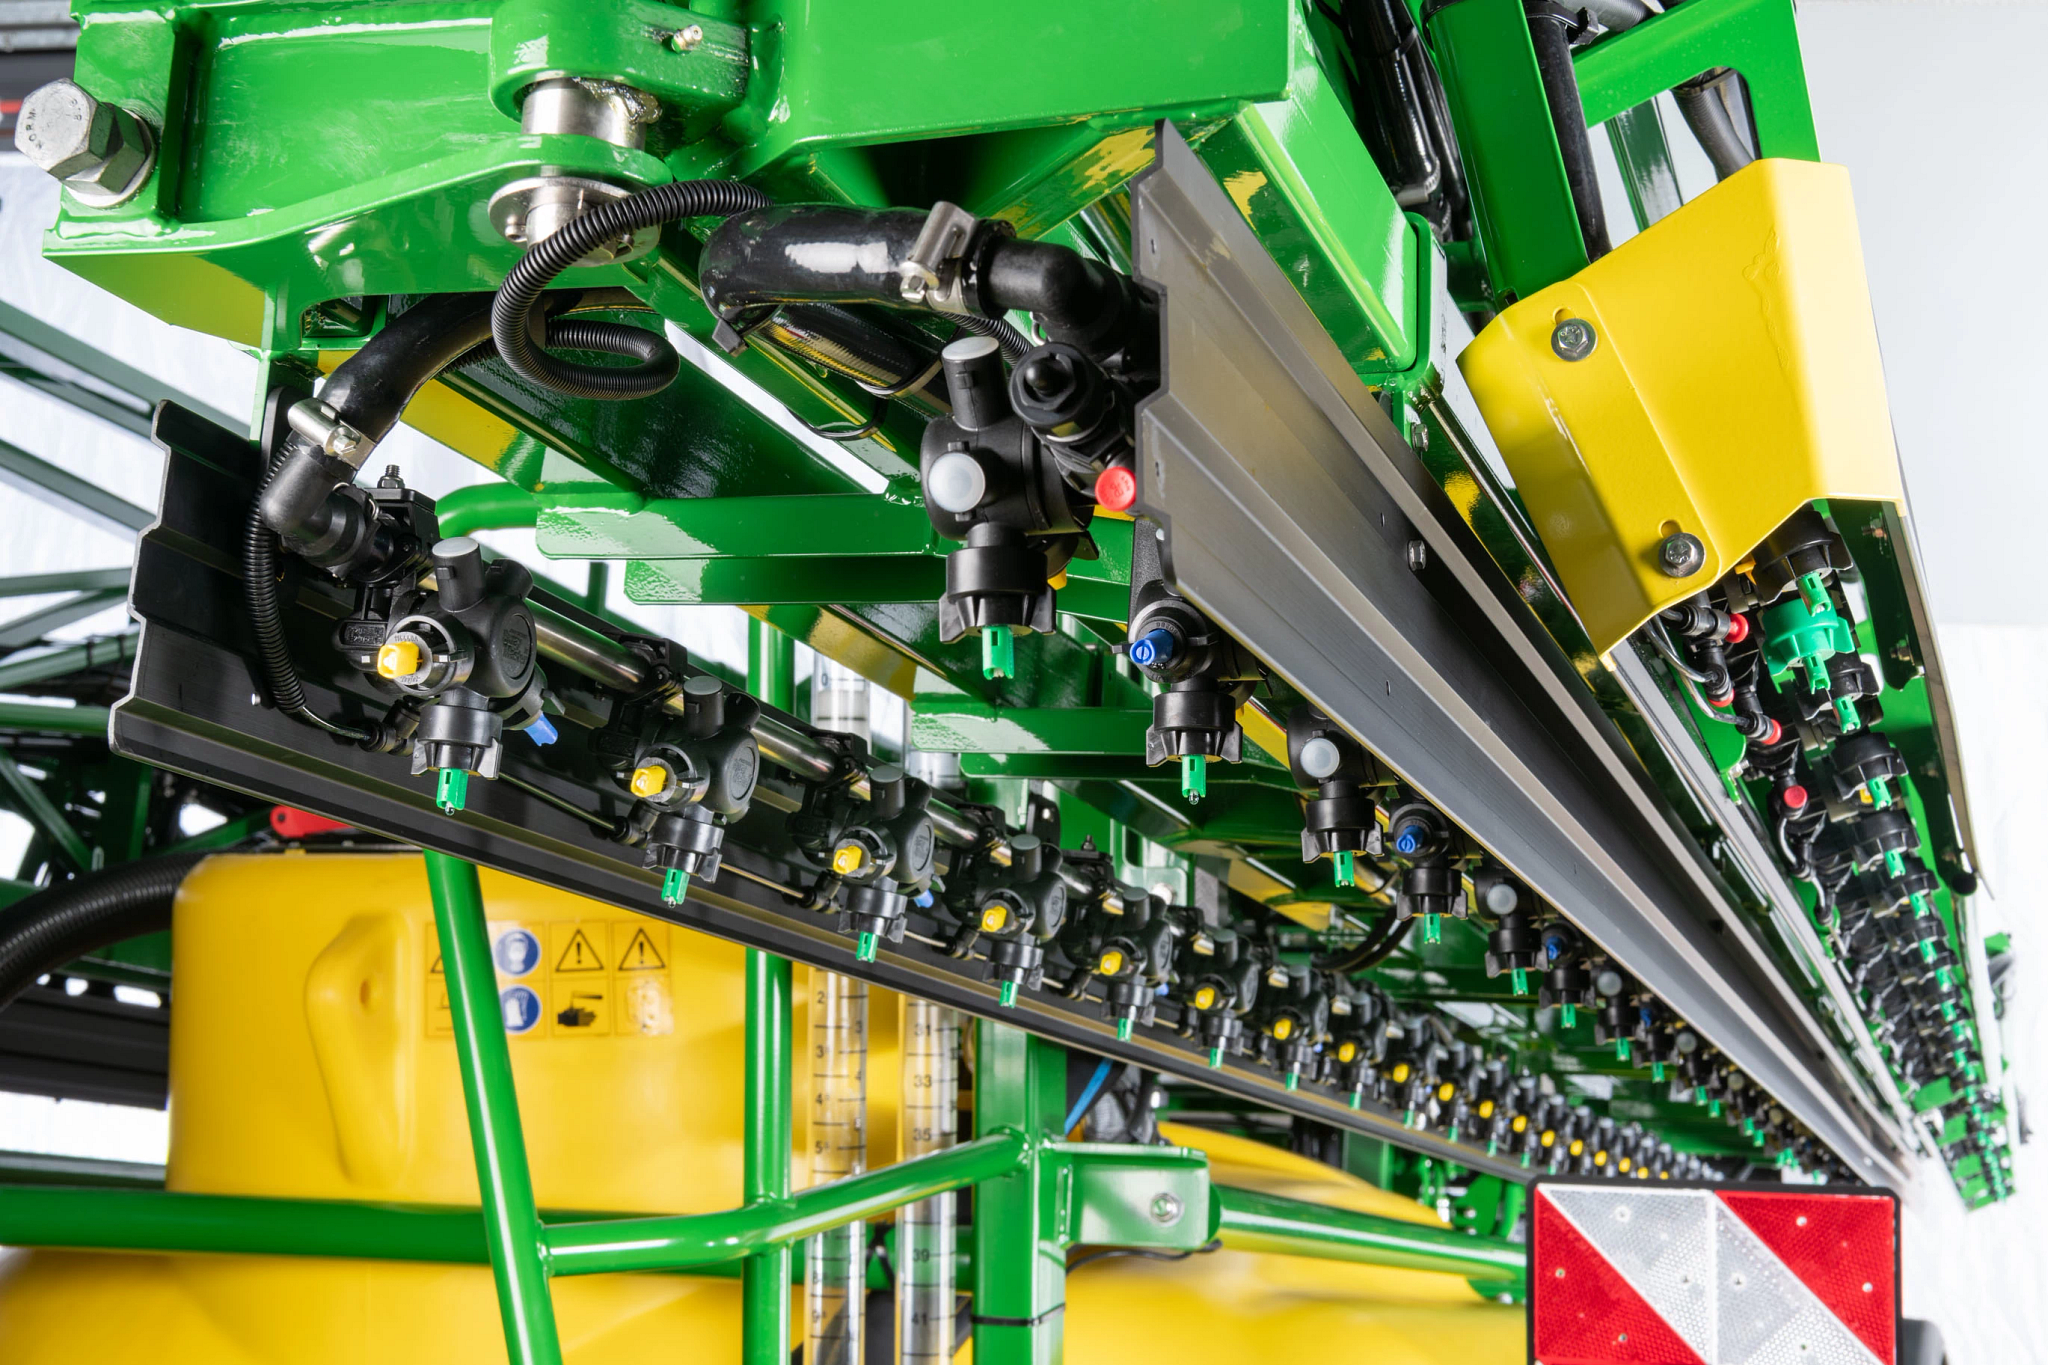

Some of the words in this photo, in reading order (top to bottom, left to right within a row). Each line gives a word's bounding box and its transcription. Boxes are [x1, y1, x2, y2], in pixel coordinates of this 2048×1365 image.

[913, 1074, 932, 1088] 33
[913, 1127, 932, 1142] 35
[913, 1248, 930, 1262] 39
